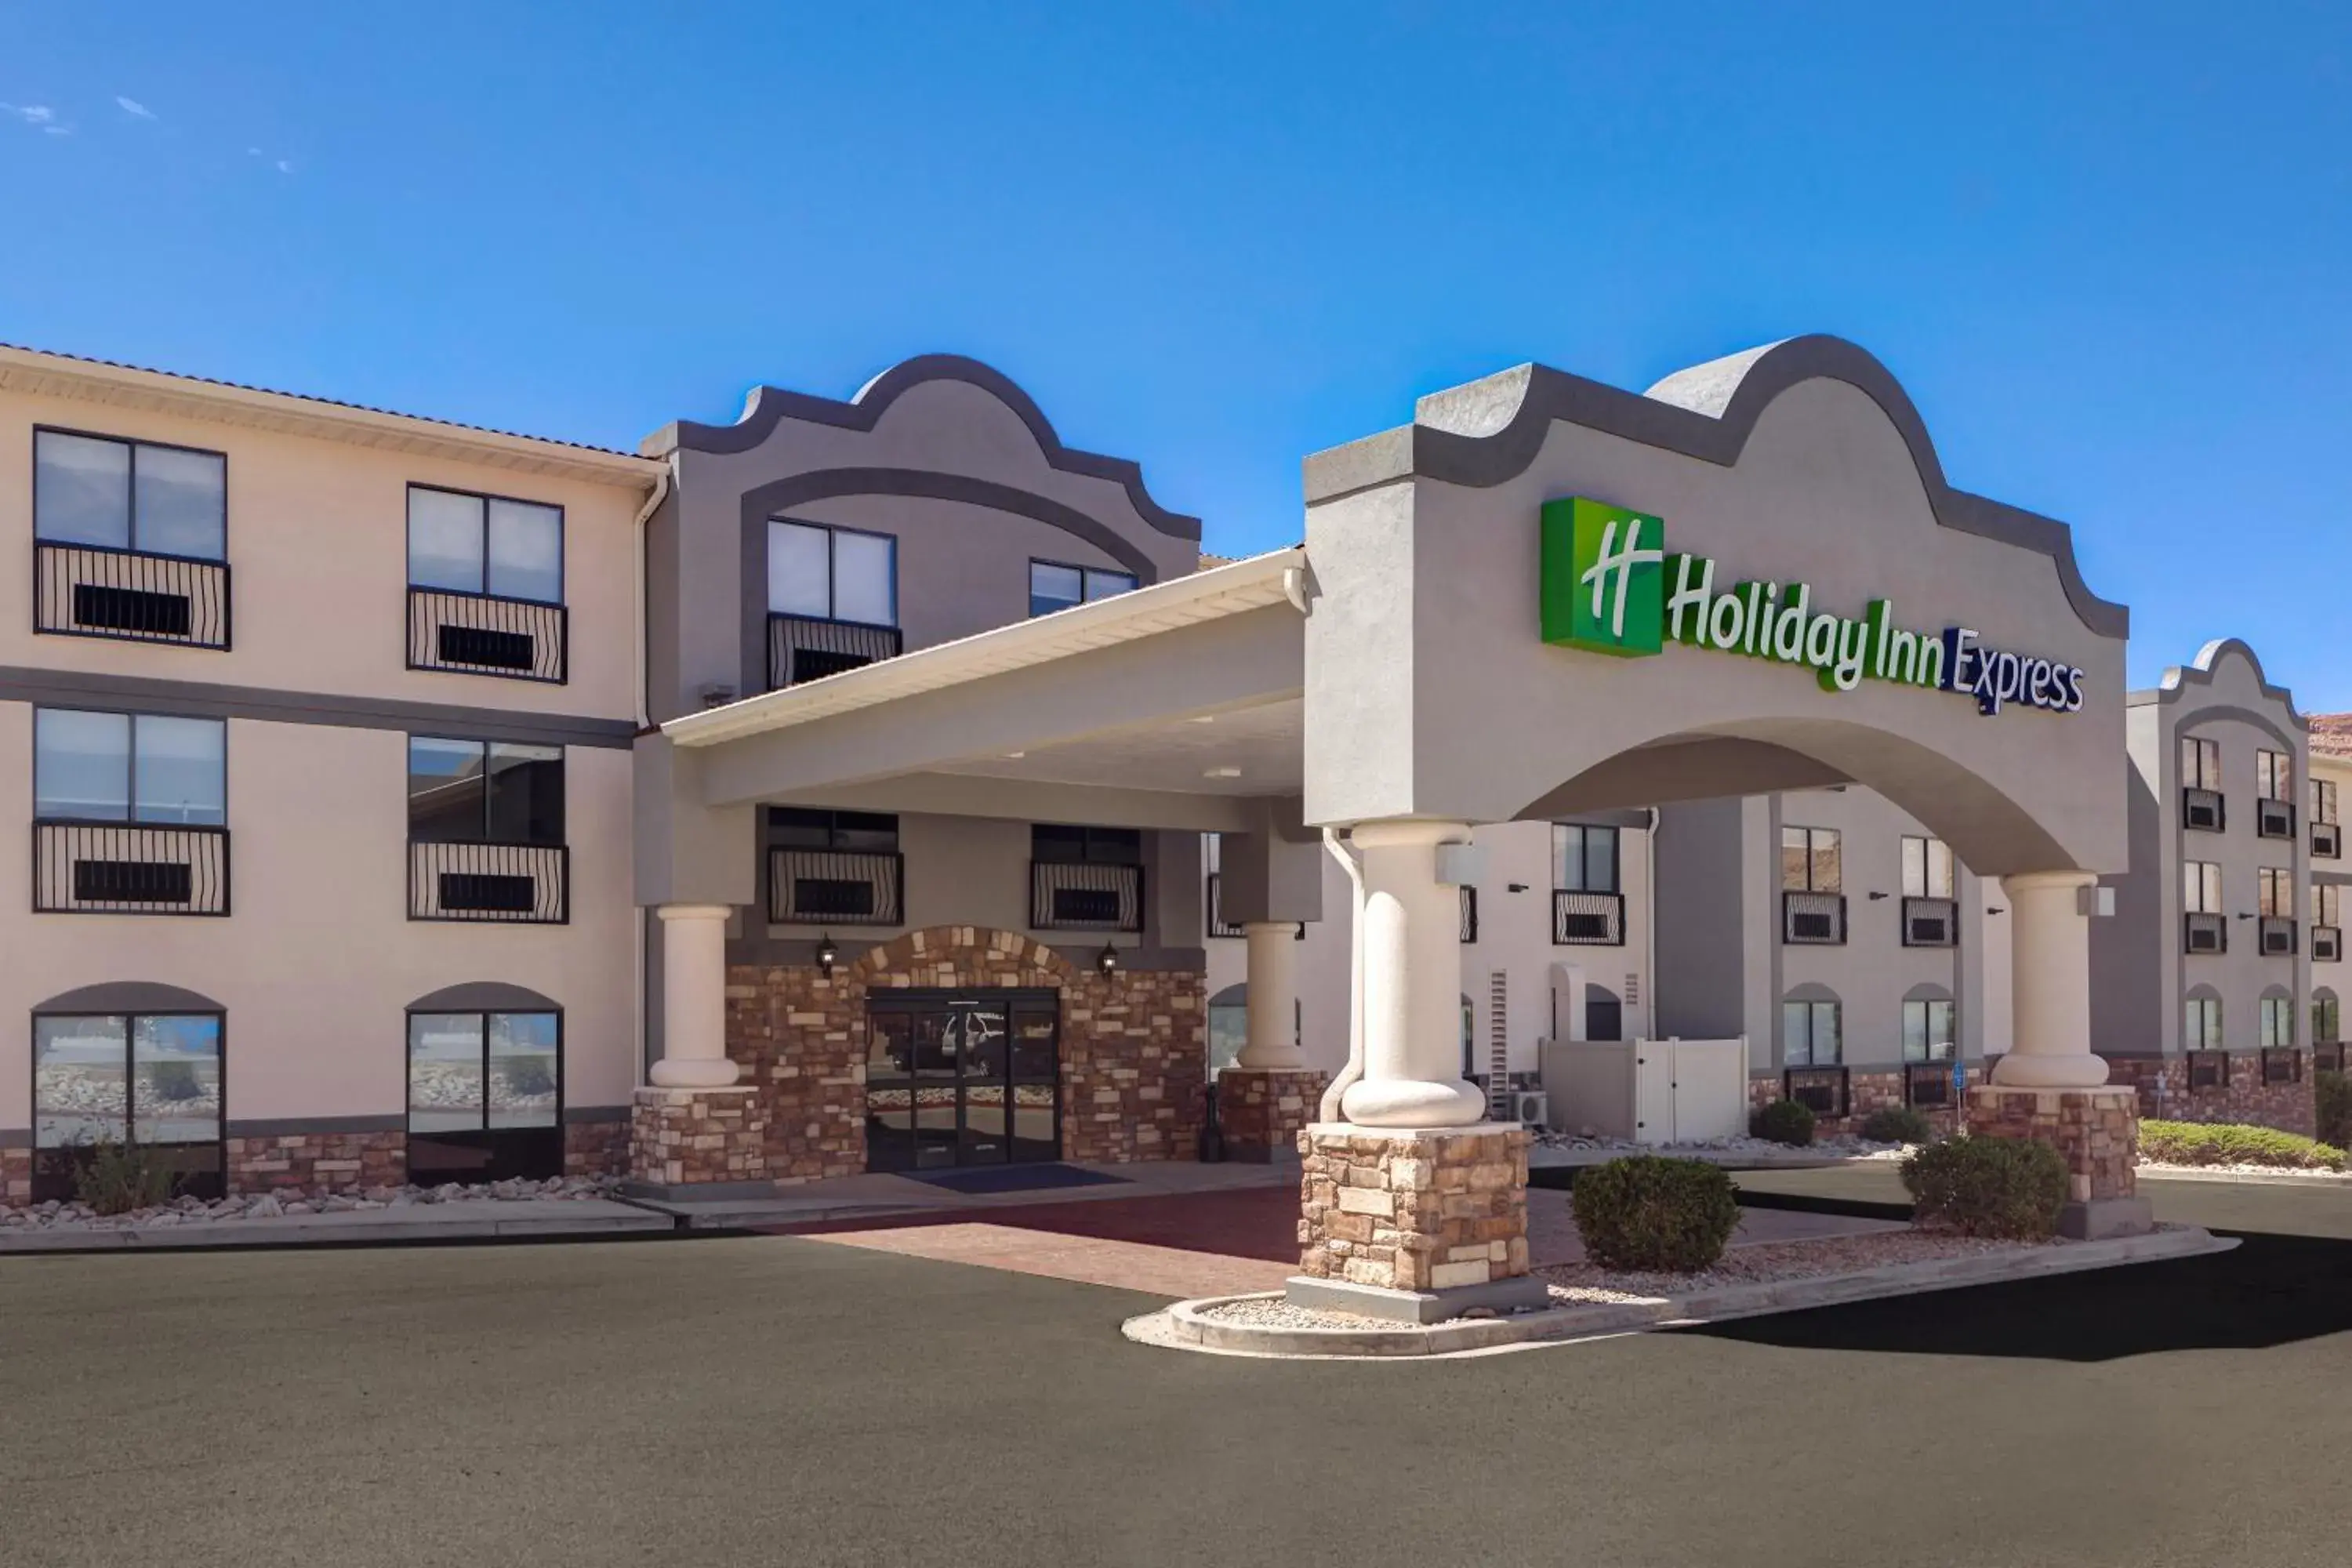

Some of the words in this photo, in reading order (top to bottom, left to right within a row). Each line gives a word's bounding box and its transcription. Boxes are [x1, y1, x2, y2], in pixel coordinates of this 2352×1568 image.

[1668, 554, 1869, 691] Holiday
[1876, 599, 1944, 689] Inn
[1953, 628, 2084, 716] Express
